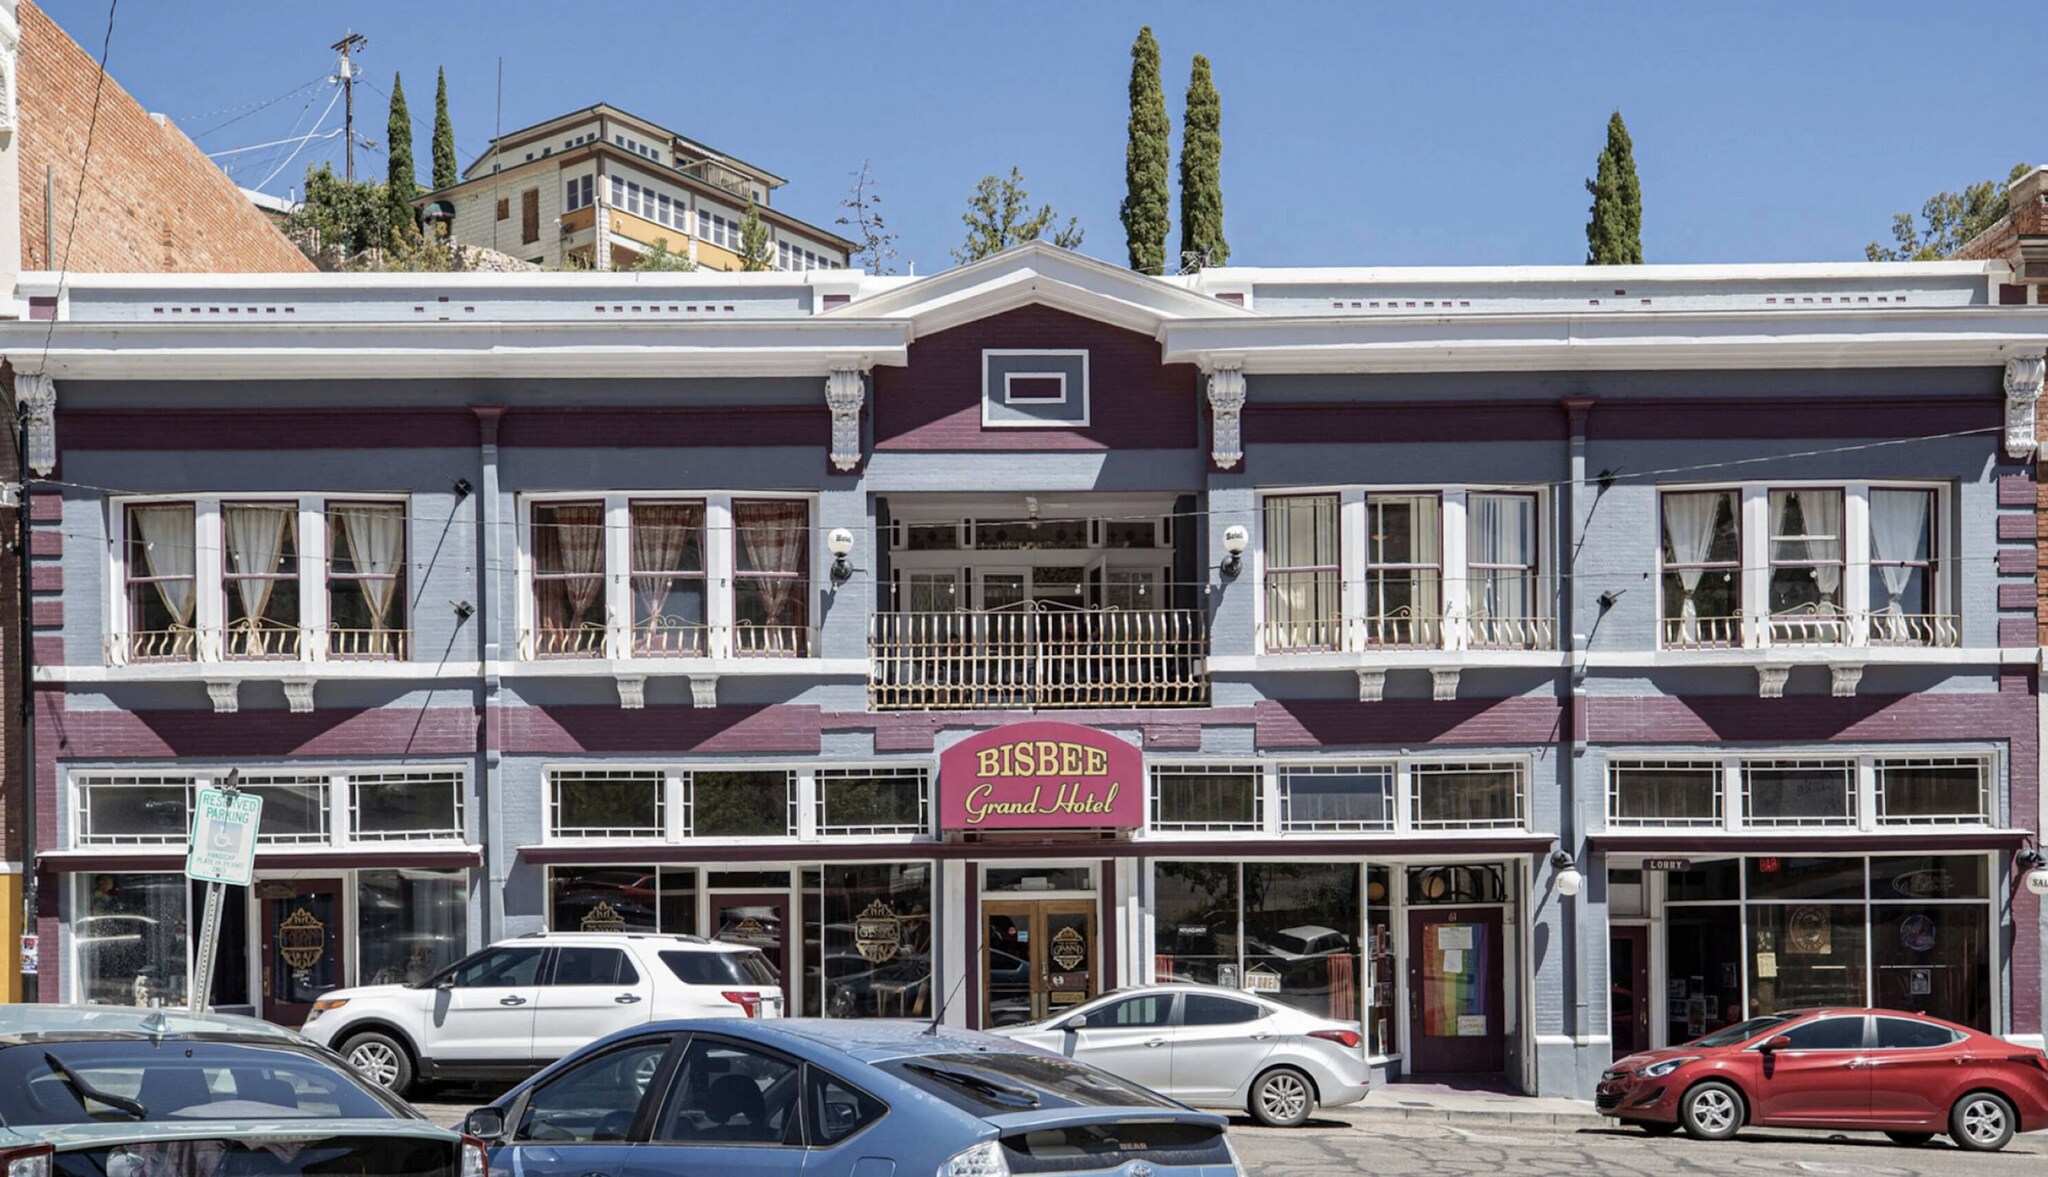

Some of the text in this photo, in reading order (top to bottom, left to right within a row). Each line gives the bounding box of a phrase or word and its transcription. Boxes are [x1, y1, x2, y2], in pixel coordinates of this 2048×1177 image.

[975, 740, 1109, 778] BISBEE
[202, 793, 257, 812] RESRVED
[964, 782, 1120, 825] Grand Hotel
[205, 807, 250, 824] PARKING
[1650, 861, 1683, 869] LOBBY
[1448, 912, 1457, 922] 61
